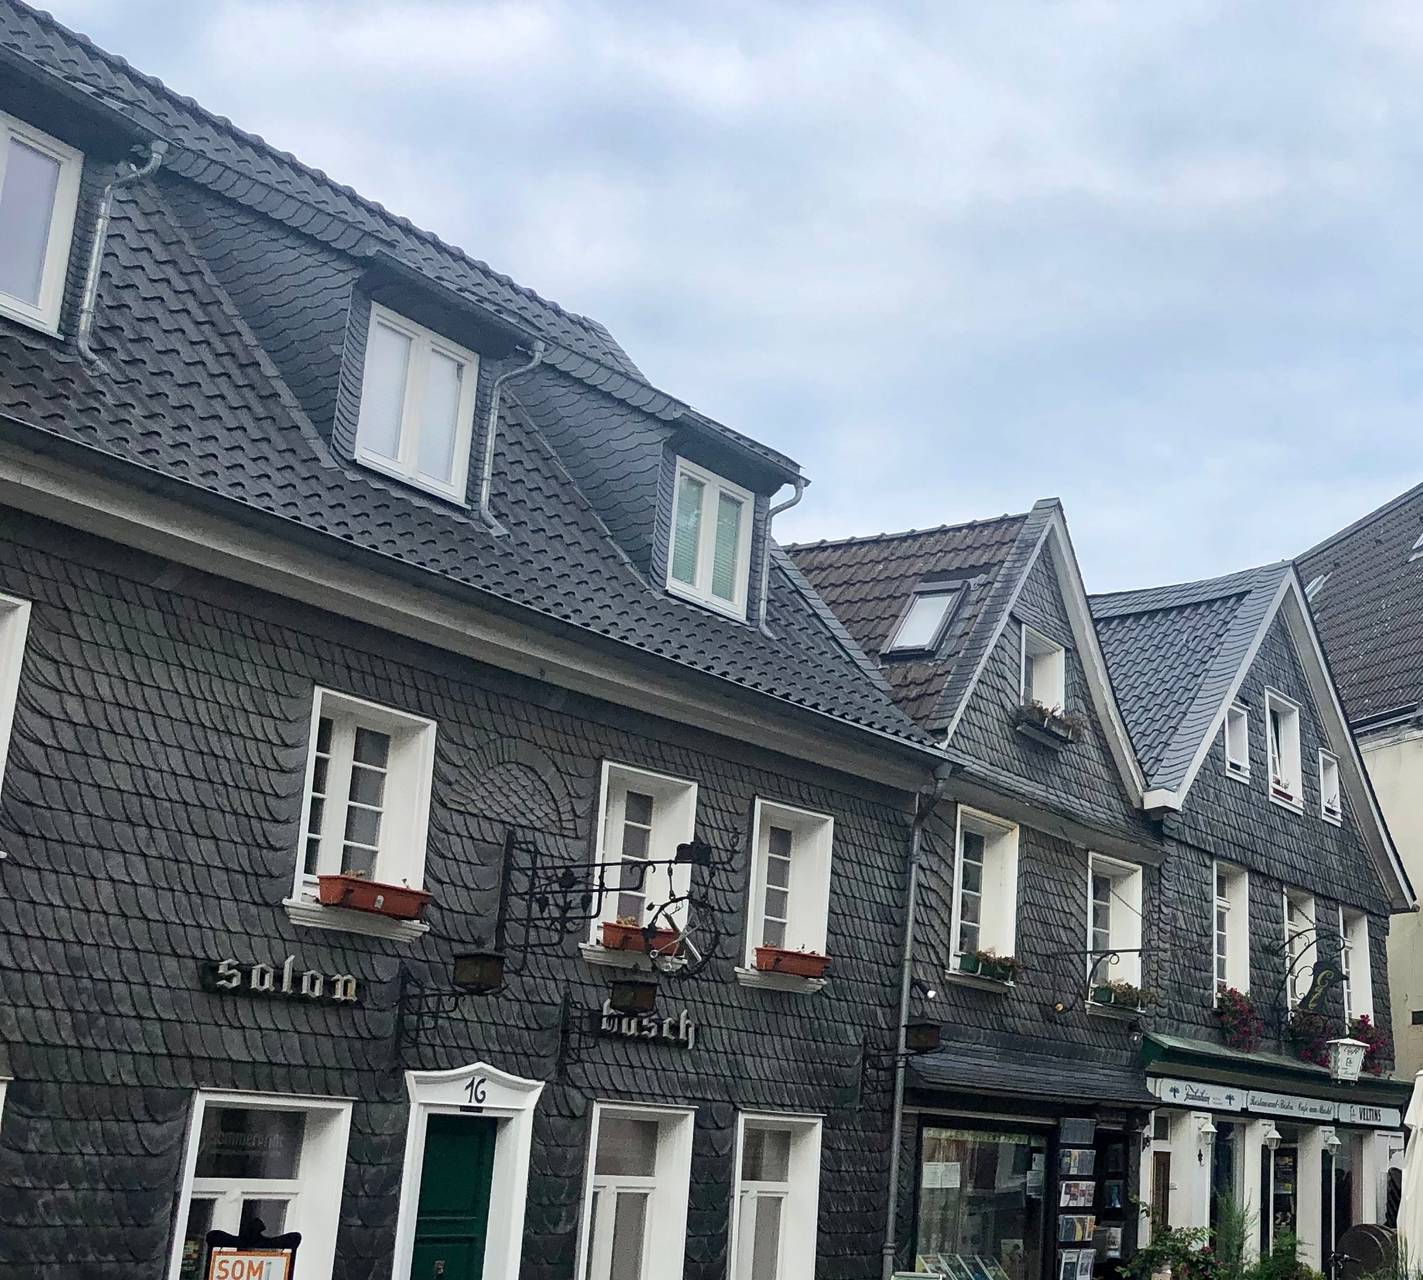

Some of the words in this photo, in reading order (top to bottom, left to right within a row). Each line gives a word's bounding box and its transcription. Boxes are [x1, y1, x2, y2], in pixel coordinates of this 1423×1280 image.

[216, 954, 358, 1003] salon
[464, 1076, 487, 1104] 16
[1358, 1106, 1382, 1122] VELTINS
